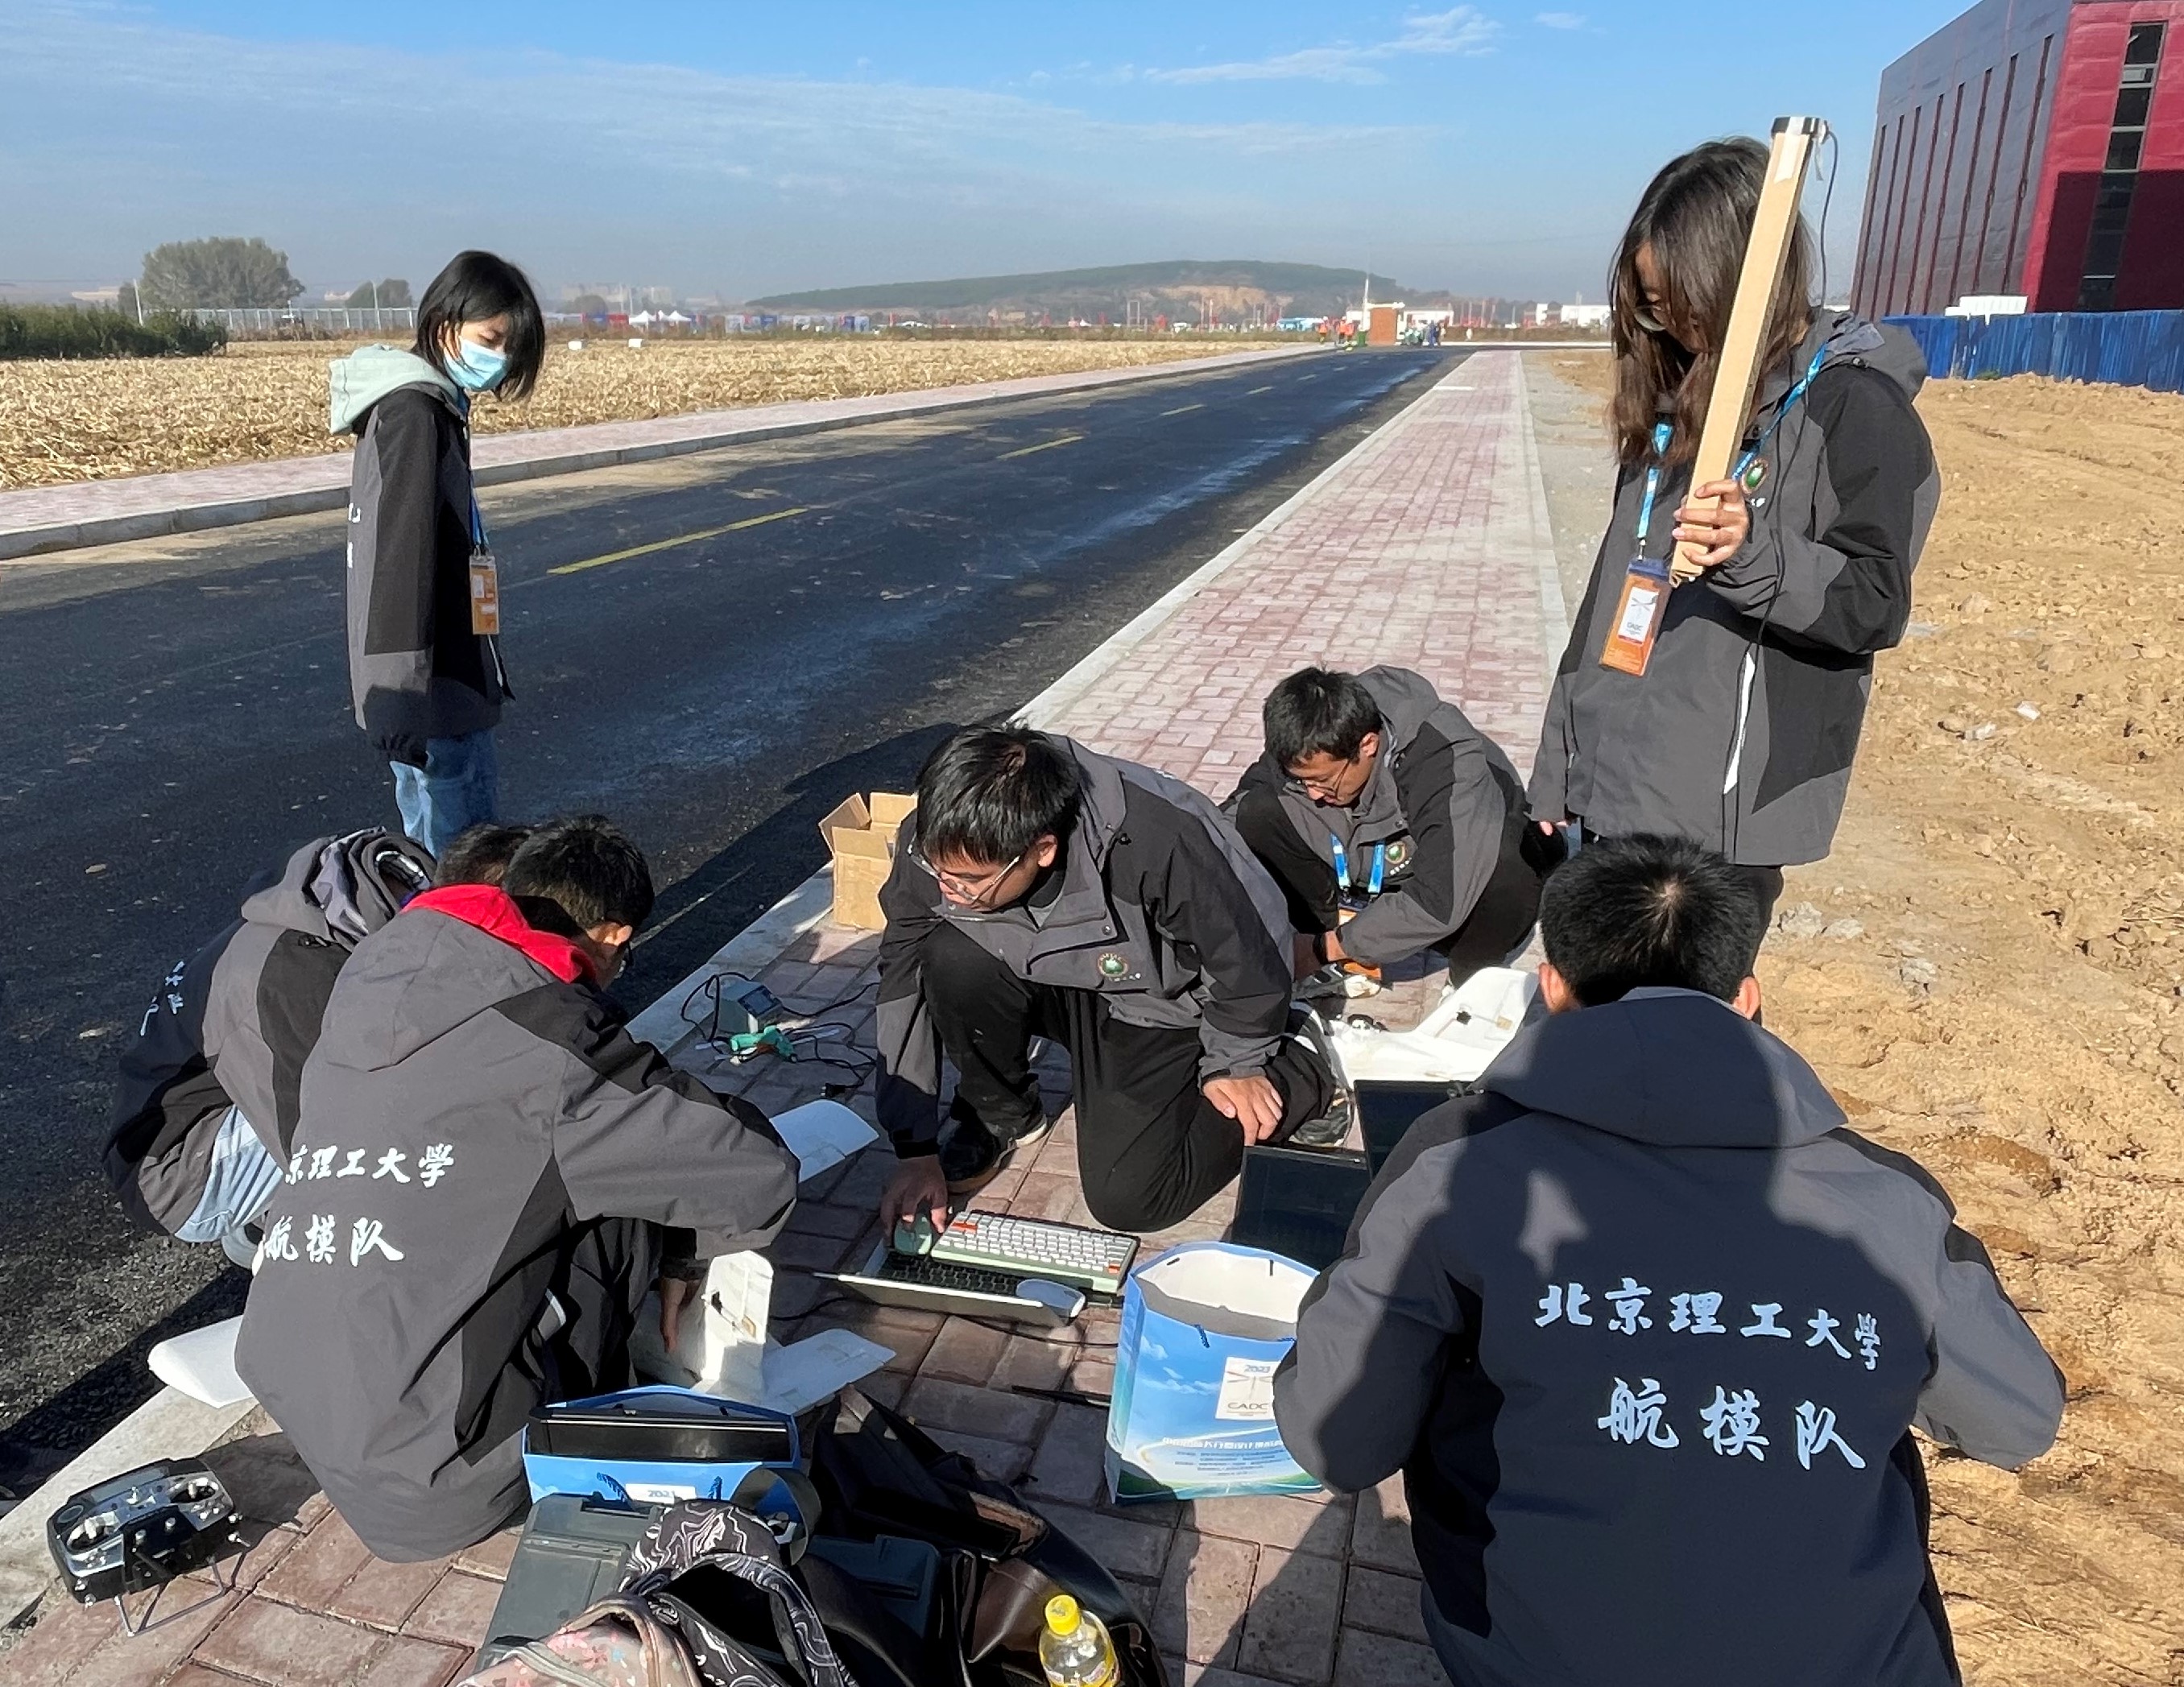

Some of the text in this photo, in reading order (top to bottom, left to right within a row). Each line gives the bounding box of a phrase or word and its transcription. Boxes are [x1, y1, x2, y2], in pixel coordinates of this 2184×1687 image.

[1227, 1402, 1269, 1410] CADC
[1598, 1376, 1866, 1470] 航模队
